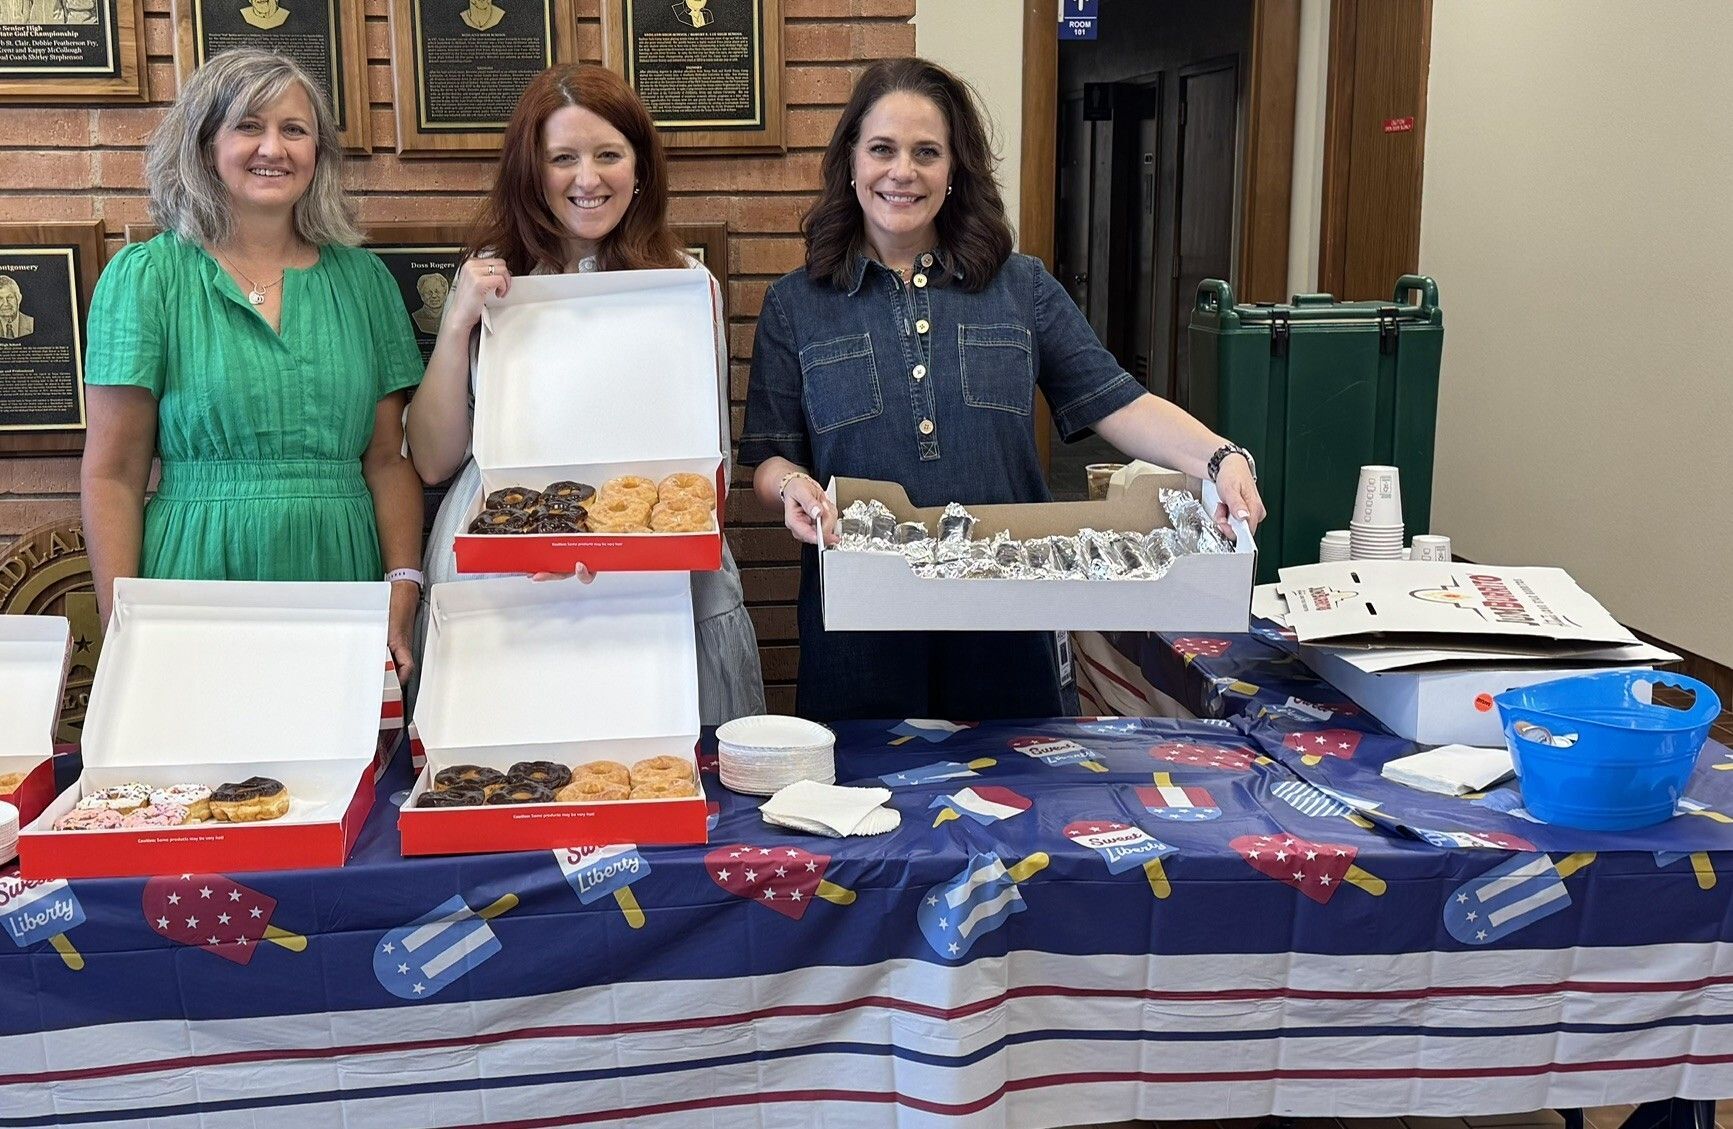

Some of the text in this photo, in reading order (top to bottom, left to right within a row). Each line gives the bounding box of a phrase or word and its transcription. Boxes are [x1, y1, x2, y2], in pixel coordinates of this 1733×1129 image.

[1068, 20, 1092, 28] ROOM
[29, 30, 79, 38] Championship
[1074, 28, 1086, 36] 101
[15, 46, 27, 54] and
[28, 54, 49, 62] Shirley
[49, 54, 84, 62] Stephenson
[429, 262, 455, 270] Rogers
[1088, 832, 1144, 847] Sweet
[1105, 841, 1167, 864] Liberty
[577, 856, 640, 894] Liberty
[9, 898, 74, 938] Liberty
